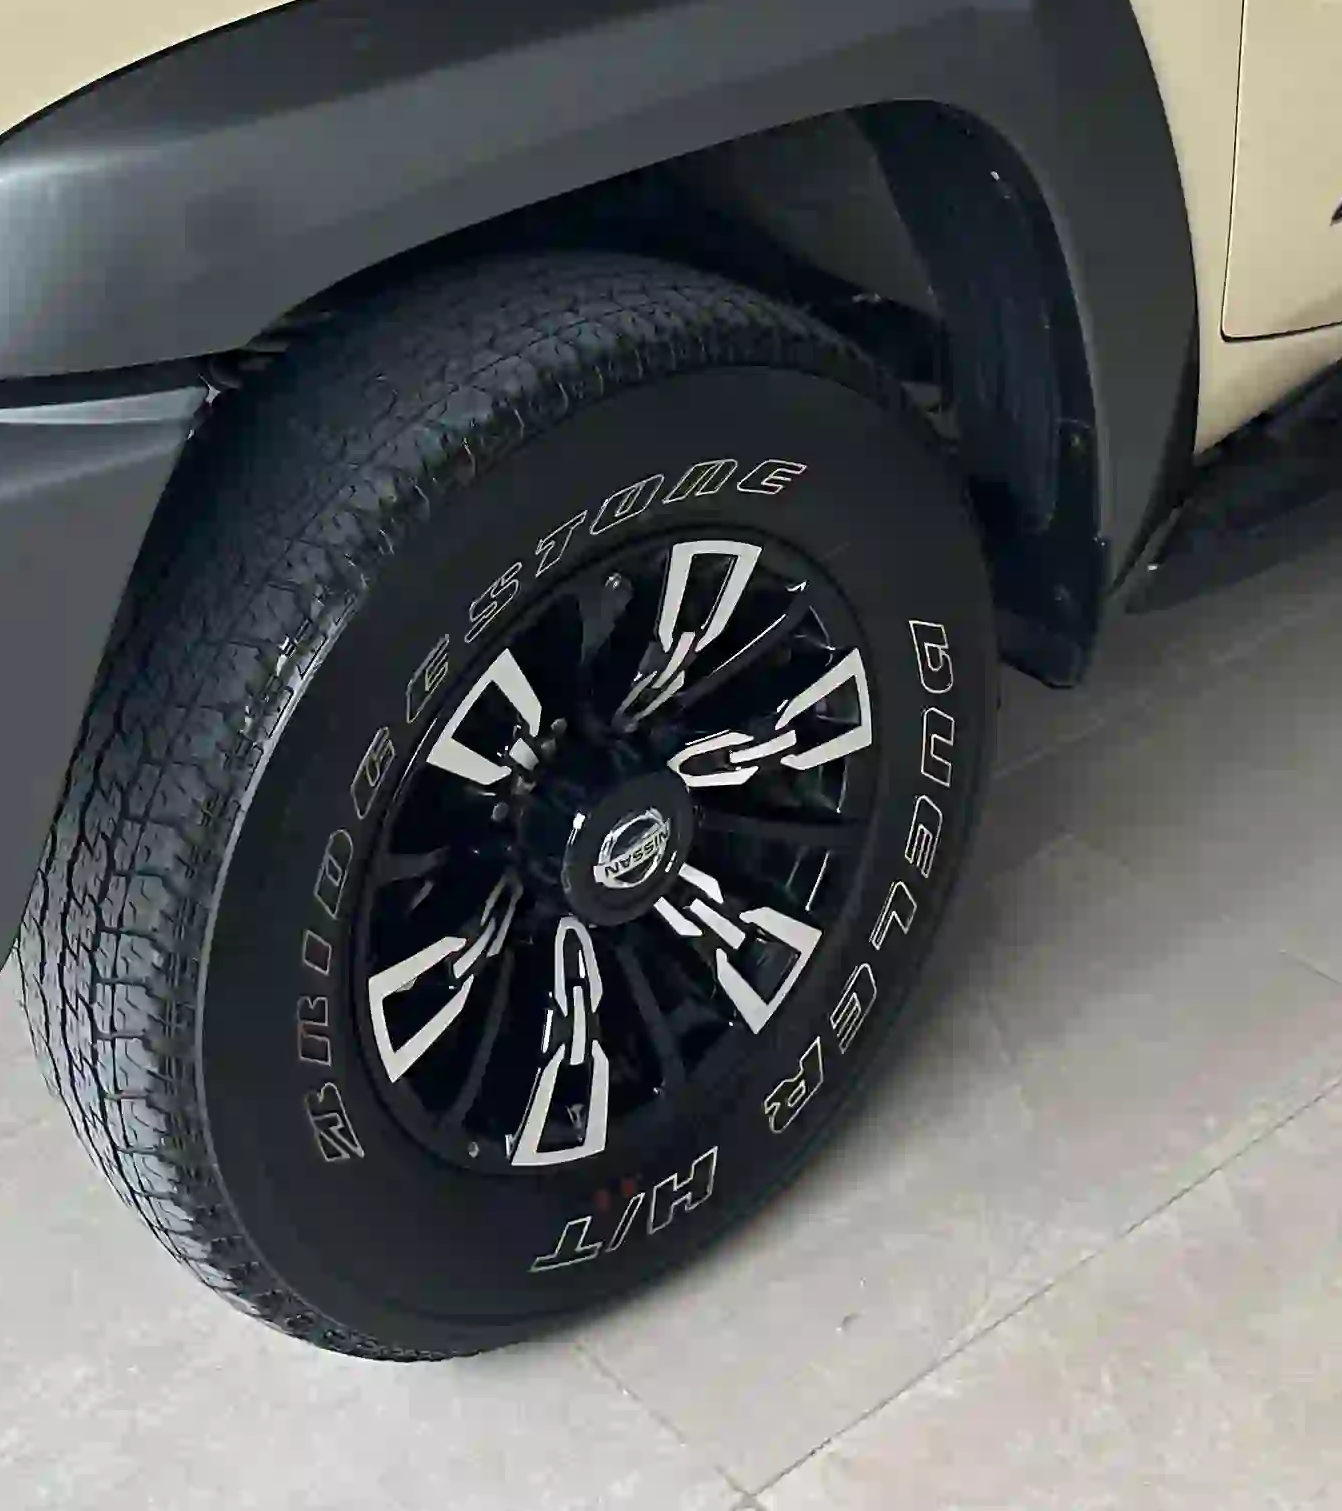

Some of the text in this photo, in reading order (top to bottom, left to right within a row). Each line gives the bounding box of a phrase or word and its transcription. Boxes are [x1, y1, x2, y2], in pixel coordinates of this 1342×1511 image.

[297, 458, 808, 1163] BRIDGESTONE
[529, 619, 954, 1274] DUELER H/T
[603, 818, 671, 879] NISSAN
